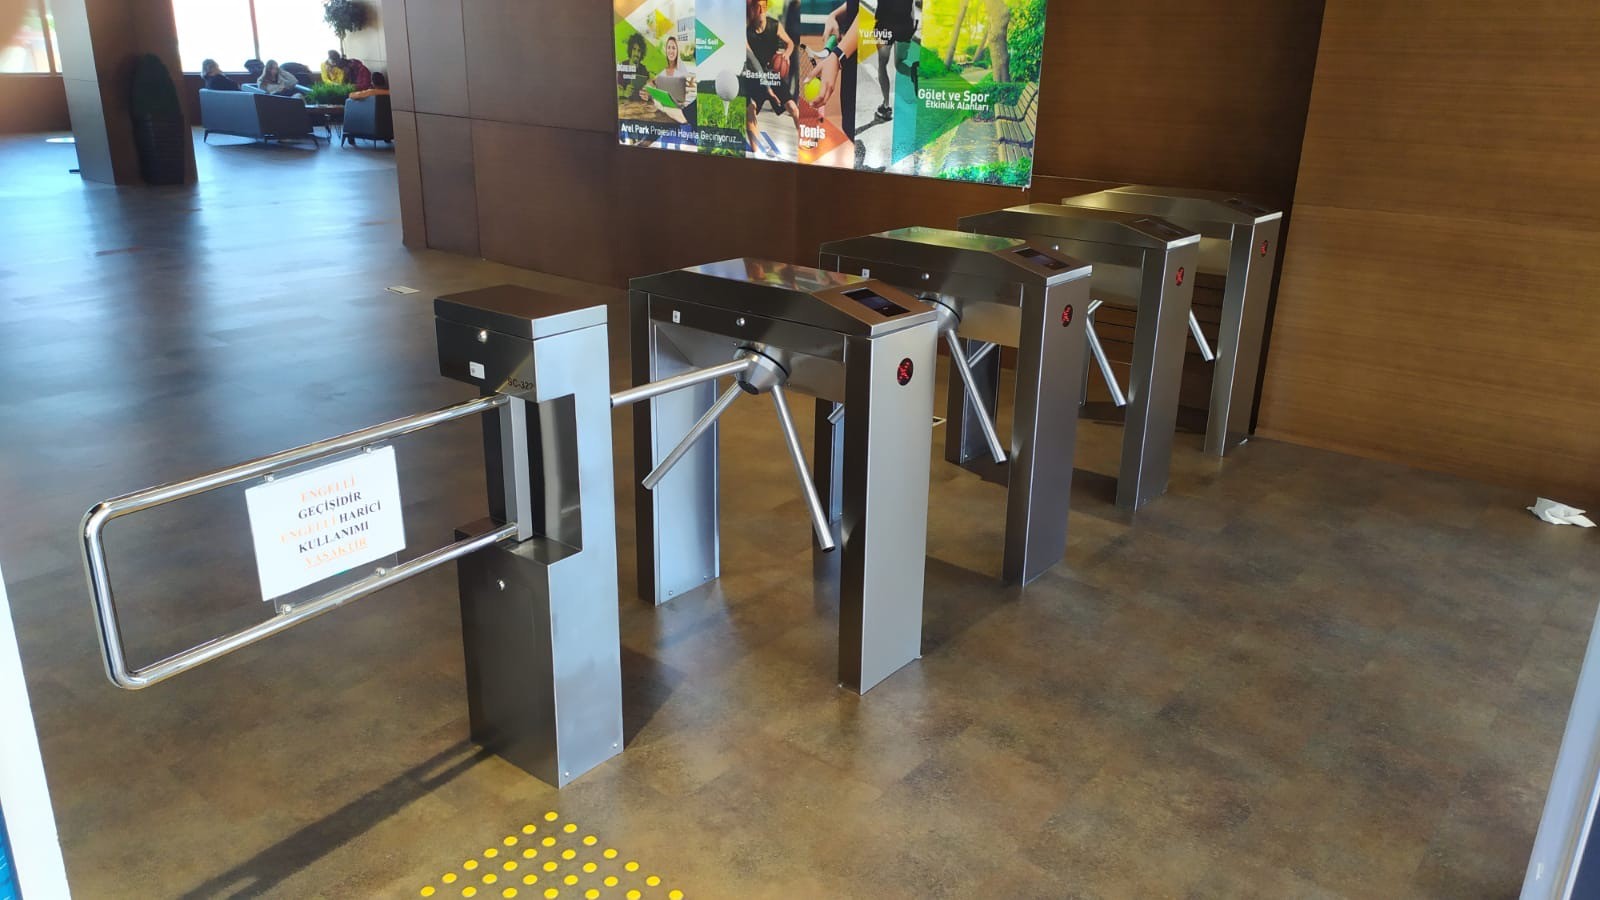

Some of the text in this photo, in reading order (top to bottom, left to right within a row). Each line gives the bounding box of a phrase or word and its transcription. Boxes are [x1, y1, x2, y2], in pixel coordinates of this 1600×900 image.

[745, 70, 781, 80] Basketbol
[917, 88, 990, 103] Gölet ve Spor
[925, 99, 955, 110] Etkinlik
[621, 123, 634, 133] Arel
[635, 125, 650, 135] Park
[650, 126, 677, 138] Projesini
[677, 128, 699, 140] Hayata
[799, 124, 827, 139] Tenis
[297, 491, 362, 520] GEÇİŞİDİR
[338, 499, 382, 523] HARİCİ
[298, 520, 369, 554] KULLANIMI
